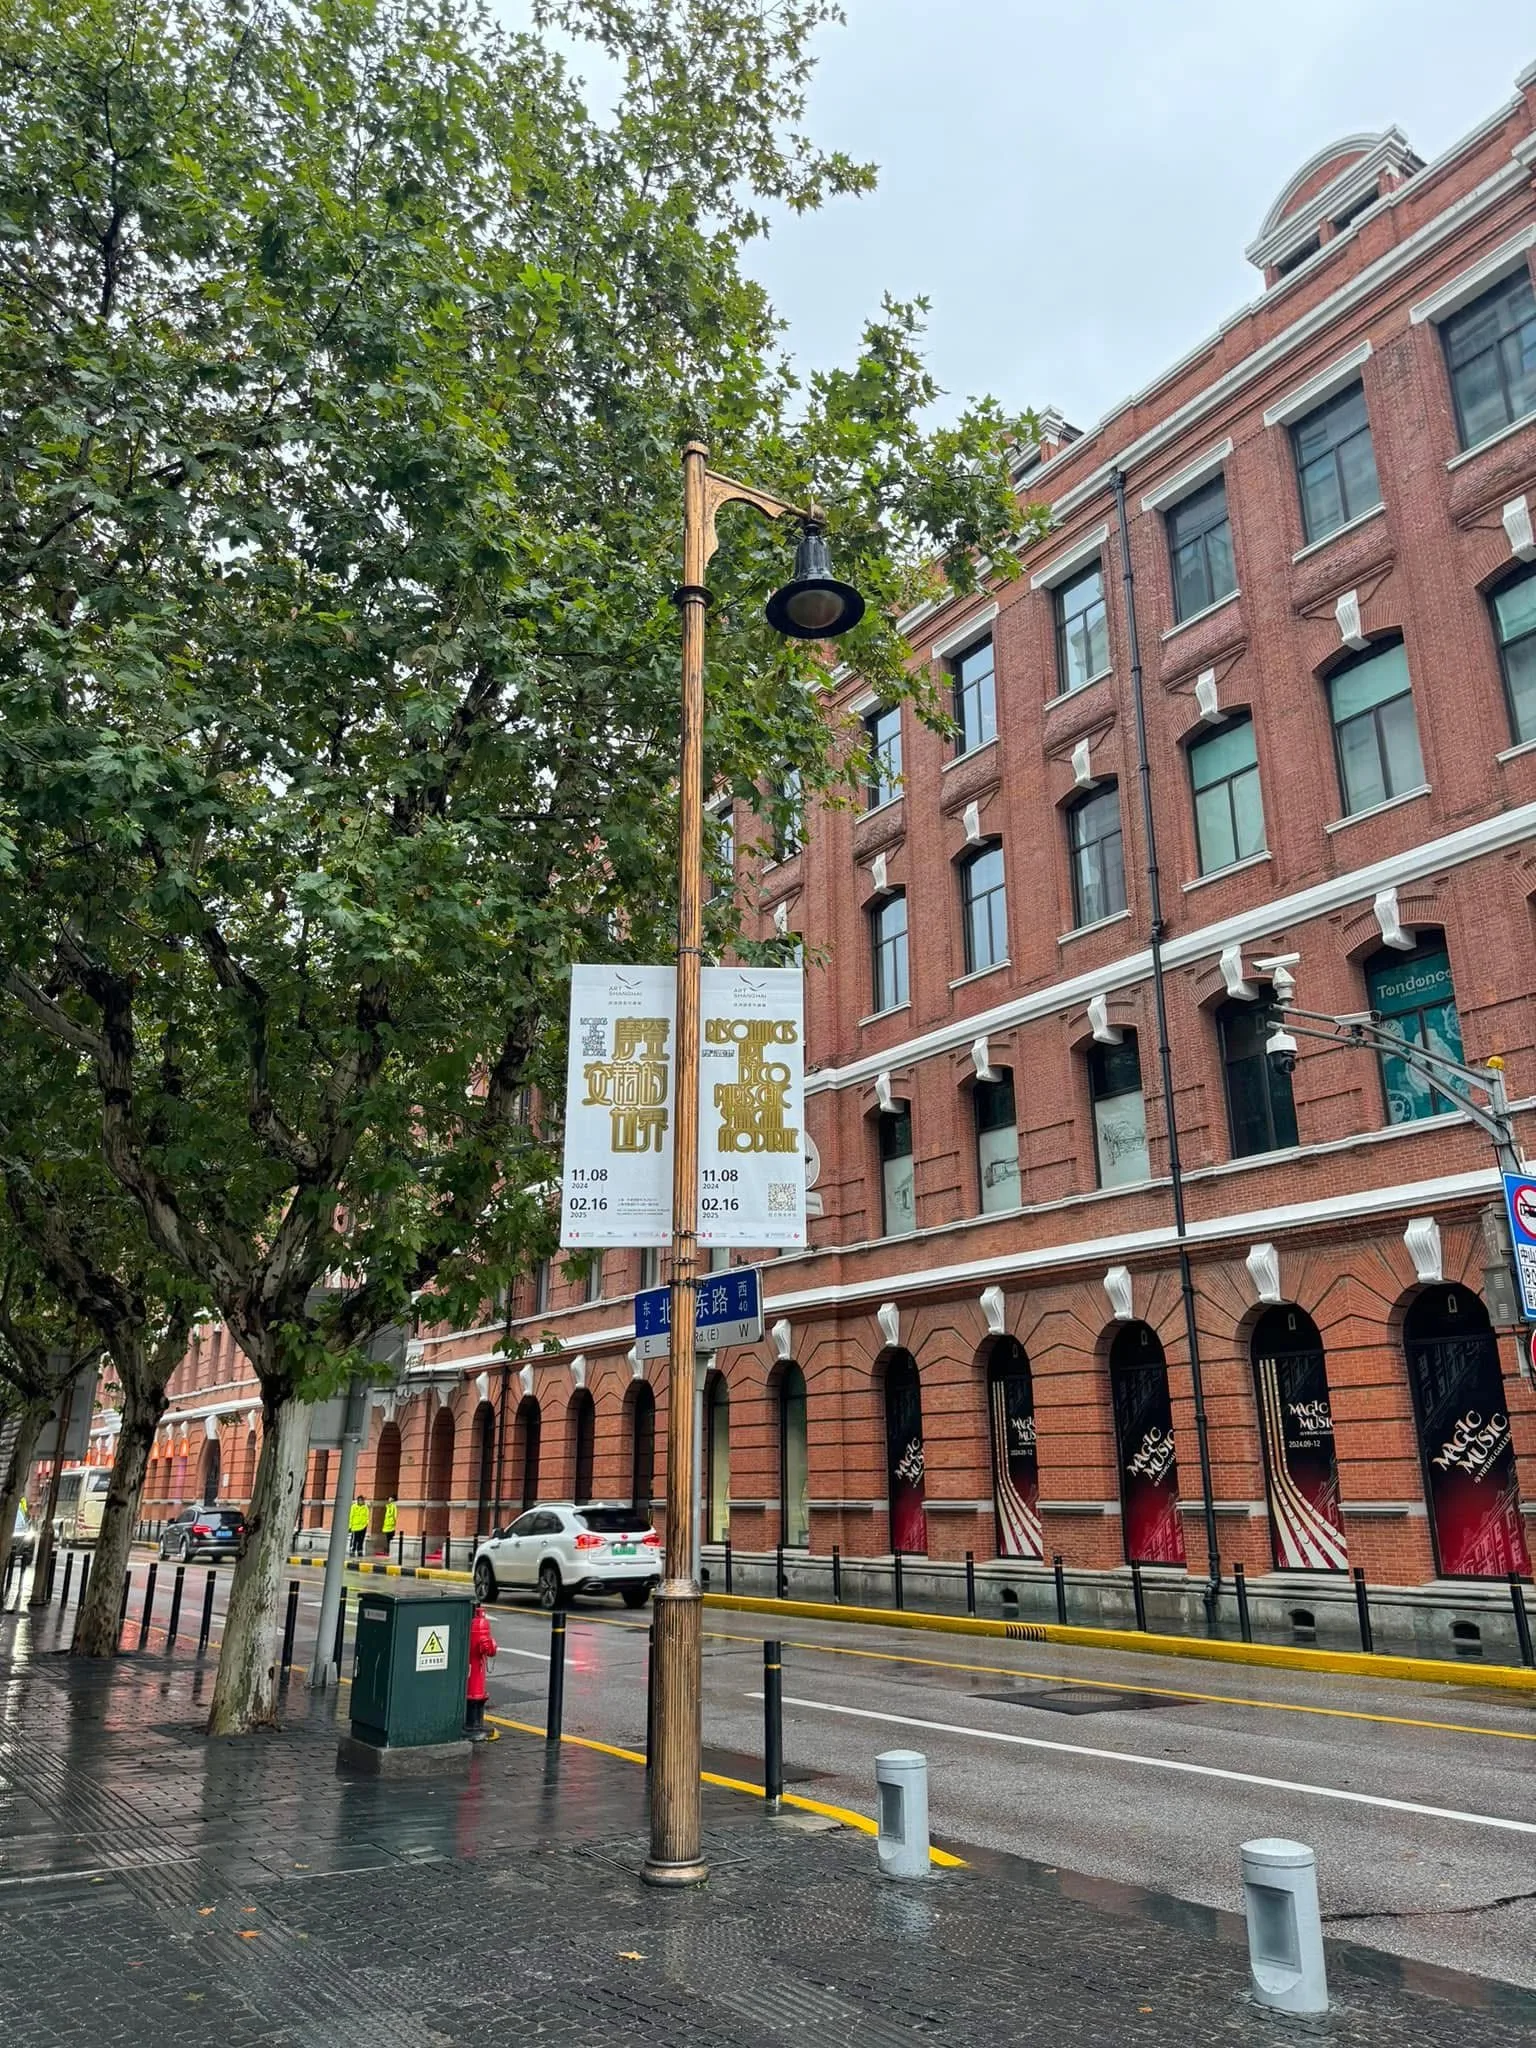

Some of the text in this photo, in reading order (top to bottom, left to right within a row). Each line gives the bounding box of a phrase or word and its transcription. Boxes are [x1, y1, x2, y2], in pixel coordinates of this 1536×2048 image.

[612, 1016, 671, 1061] 摩登
[582, 1061, 669, 1106] 交错的
[610, 1107, 669, 1153] 世界
[571, 1168, 608, 1181] 11.08
[702, 1169, 738, 1182] 11.08
[570, 1197, 608, 1210] 02.16
[701, 1198, 739, 1211] 02.16
[1520, 1248, 1536, 1264] 中山
[737, 1280, 748, 1298] 西
[643, 1301, 651, 1317] 东
[738, 1300, 748, 1312] 40
[644, 1319, 650, 1330] 2
[739, 1322, 749, 1337] W
[644, 1340, 650, 1353] E
[1288, 1400, 1329, 1417] MAGIC
[1432, 1410, 1482, 1472] MAGIC
[1456, 1412, 1508, 1475] MUSIC
[1126, 1426, 1162, 1477] MAGIC
